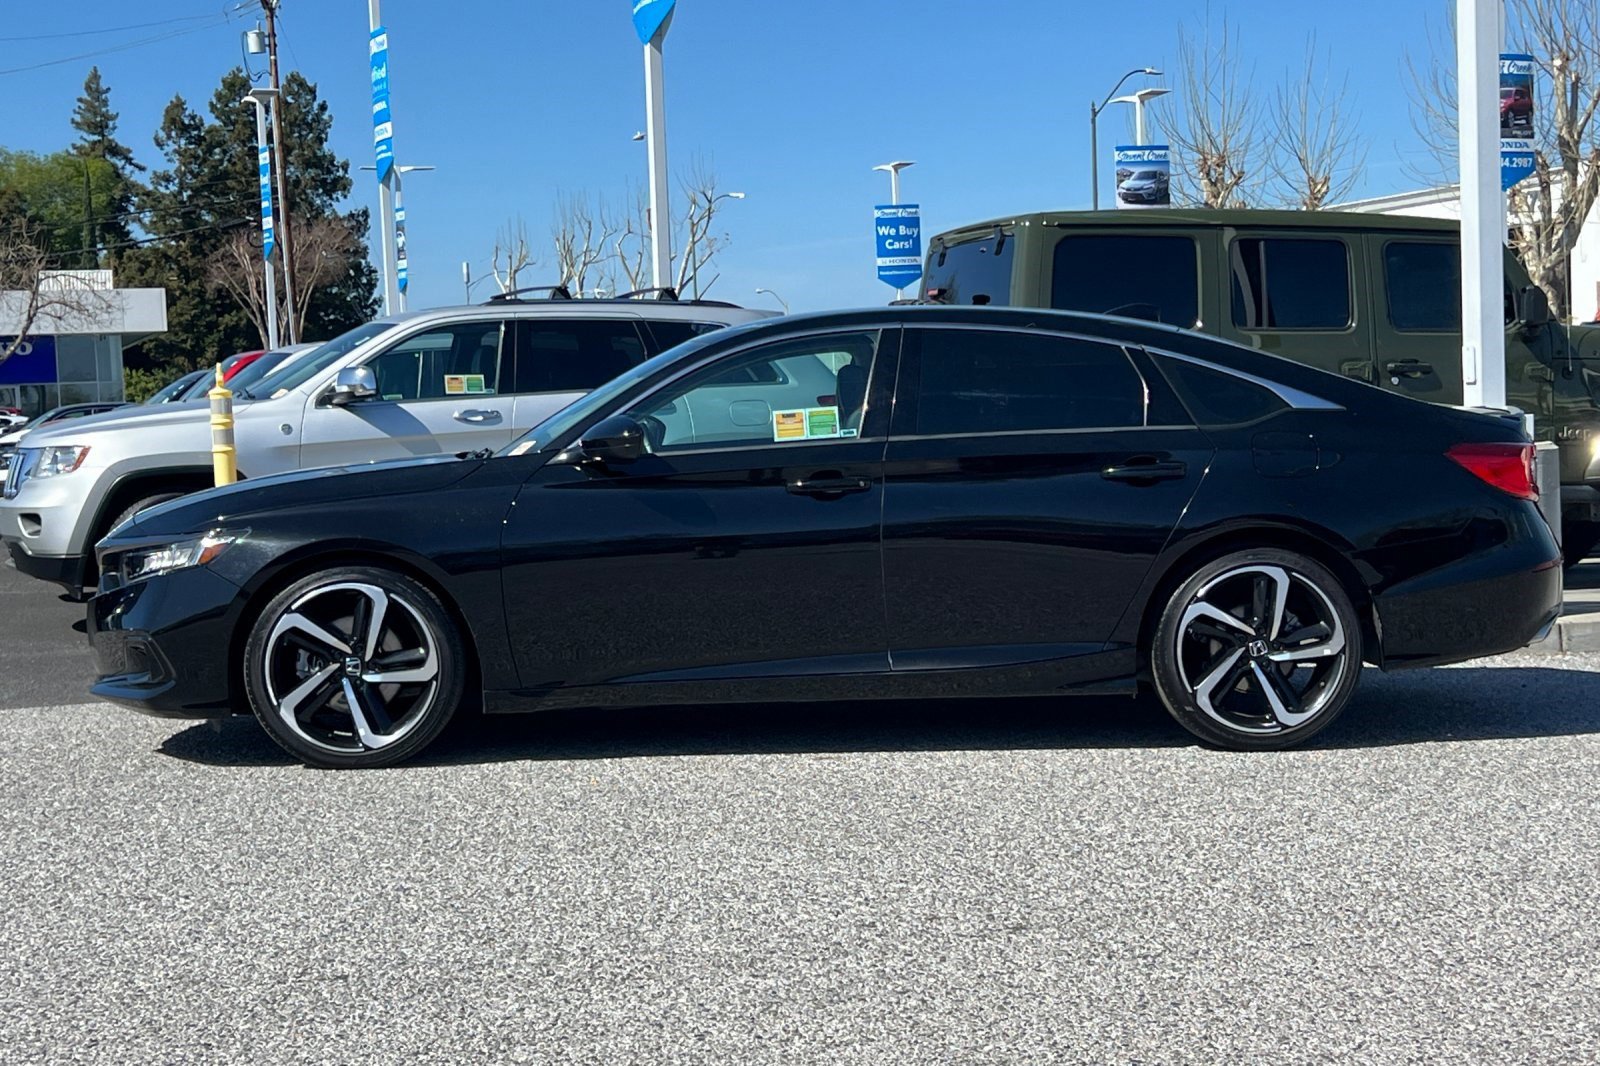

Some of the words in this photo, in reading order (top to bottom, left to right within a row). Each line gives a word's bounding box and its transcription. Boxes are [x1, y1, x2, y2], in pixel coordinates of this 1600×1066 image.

[877, 225, 897, 236] We
[898, 225, 919, 238] Buy
[885, 239, 913, 250] Cars!
[1558, 426, 1592, 441] Jeep
